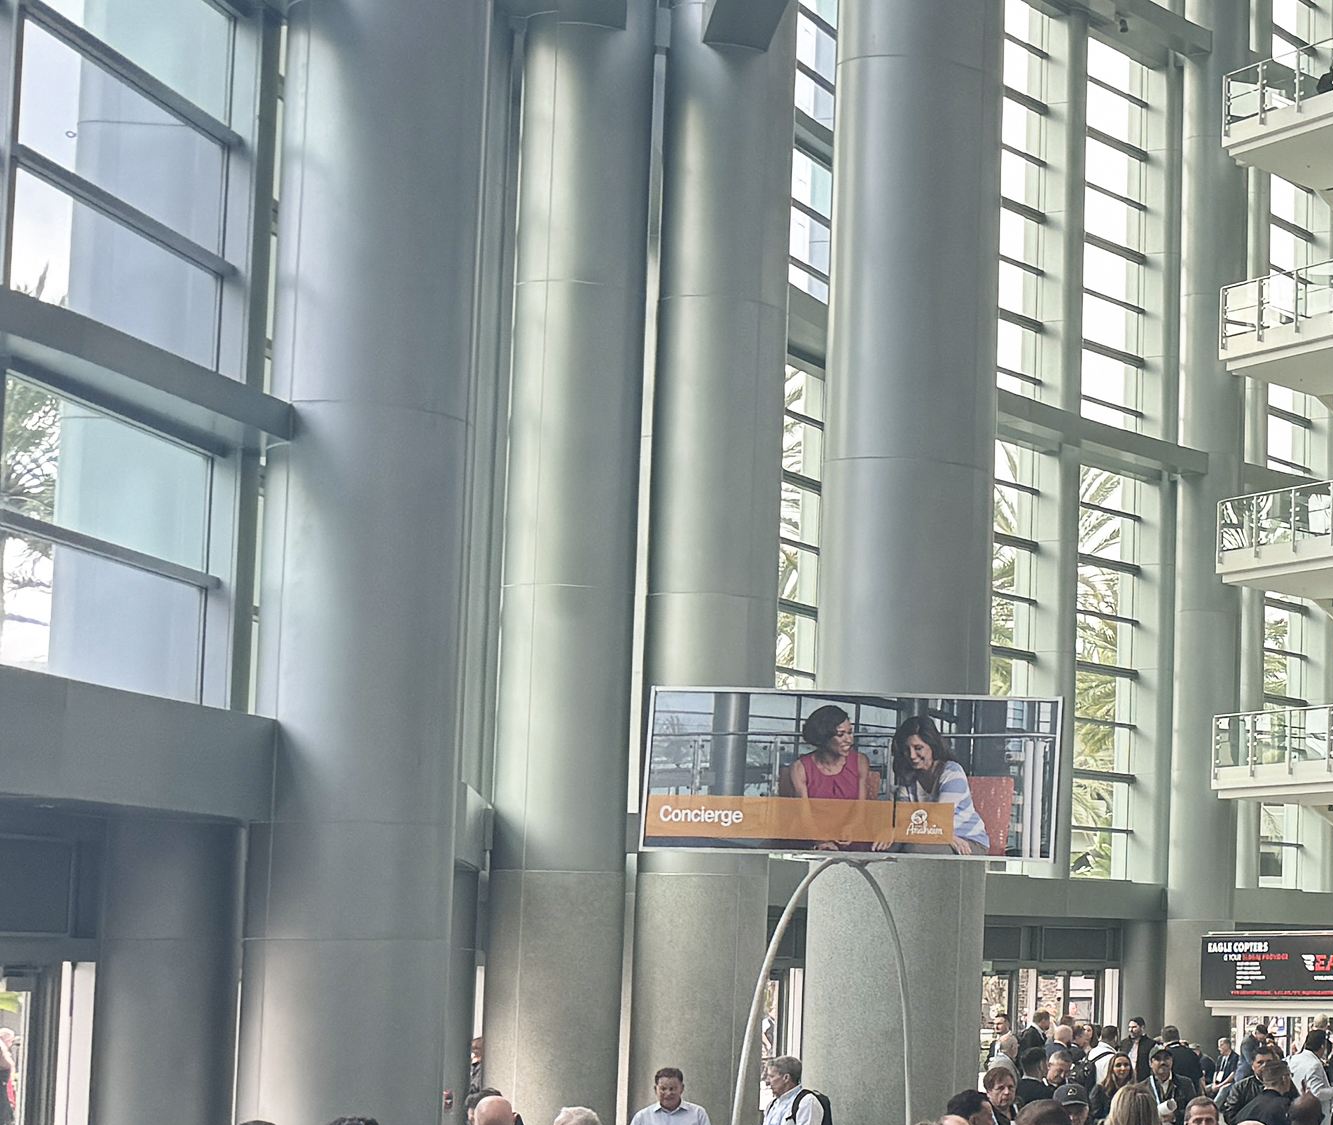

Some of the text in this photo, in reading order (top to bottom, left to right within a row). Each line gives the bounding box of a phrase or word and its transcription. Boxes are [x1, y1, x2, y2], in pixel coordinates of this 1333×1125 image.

[659, 805, 744, 826] Concierge
[1207, 942, 1269, 953] EAGLE COPTERS
[1228, 953, 1242, 961] YOUR
